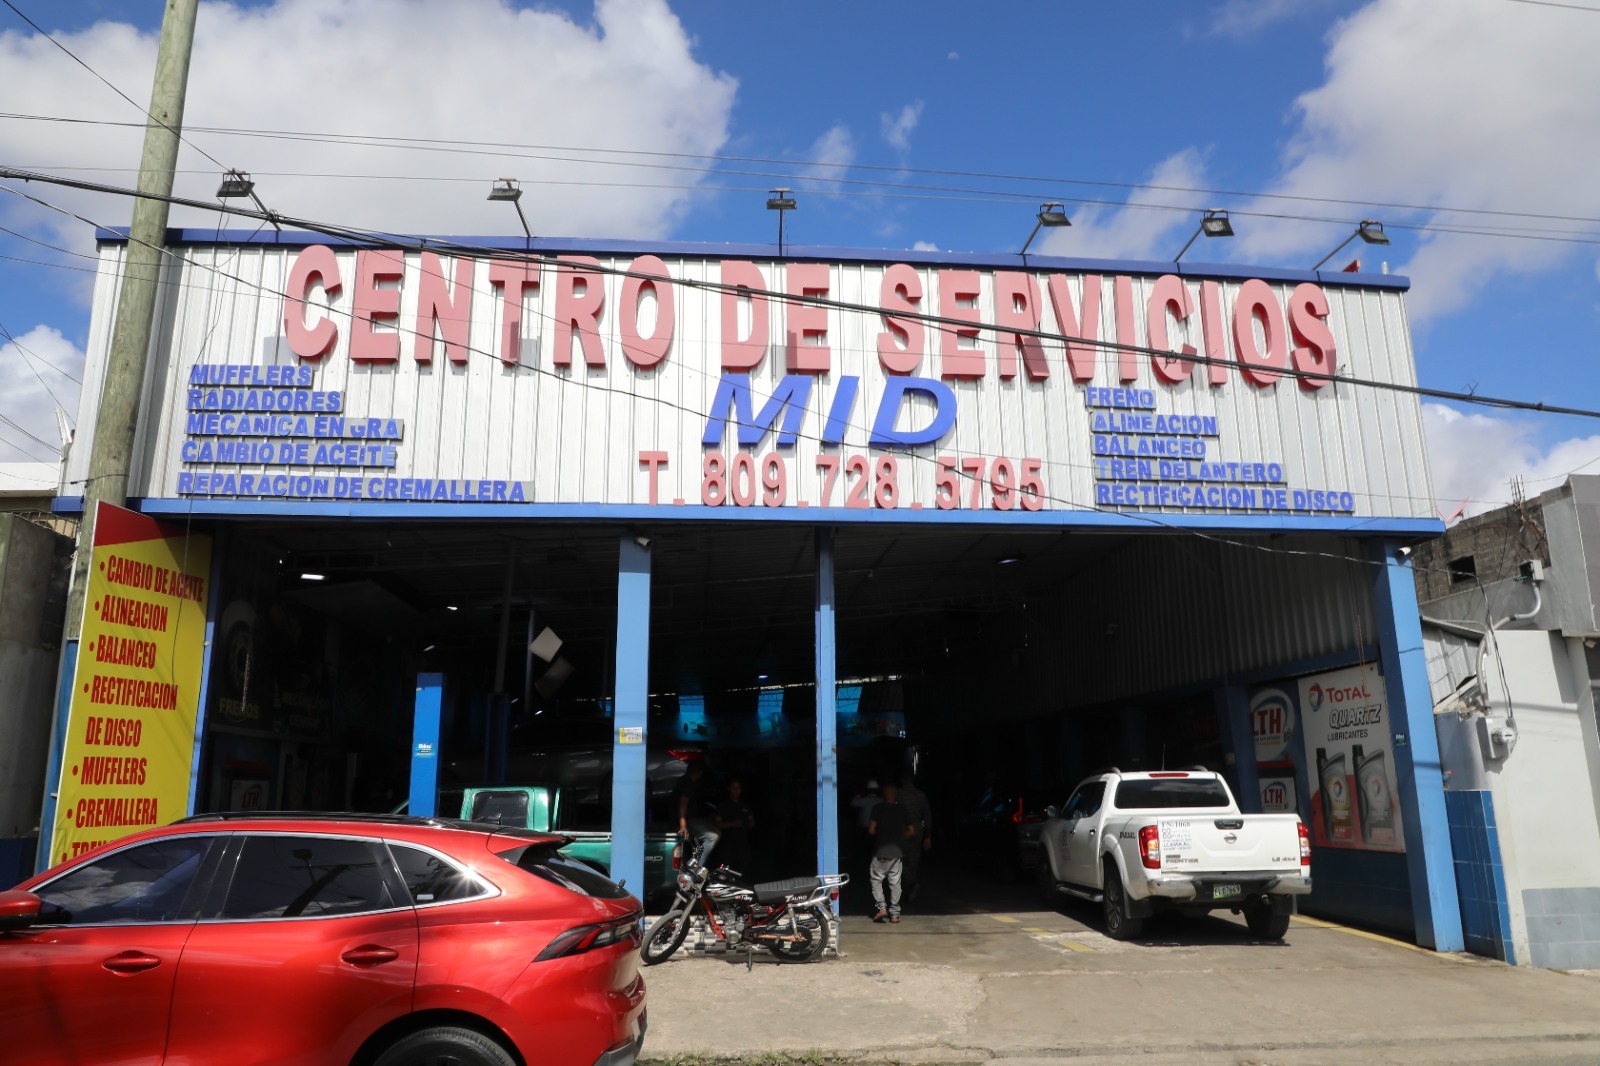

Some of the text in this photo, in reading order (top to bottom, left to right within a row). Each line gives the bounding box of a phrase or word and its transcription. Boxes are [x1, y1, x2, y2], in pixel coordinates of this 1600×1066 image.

[284, 244, 1337, 390] CENTRO DE SERVICIOS
[189, 364, 313, 386] MUFFLERS
[187, 389, 341, 411] RADIADORES
[1086, 387, 1154, 408] FRENO
[701, 374, 957, 448] MID
[1094, 411, 1217, 435] ALINEACION
[186, 413, 309, 436] MECANICA
[314, 416, 345, 437] EN
[181, 441, 397, 466] CAMBIO DE ACEITE
[1094, 435, 1206, 459] BALANCEO
[1095, 458, 1283, 483] TREN DELANTERO
[177, 472, 525, 503] REPARACION DE CREMALLERA
[1097, 484, 1355, 512] RECTIFICACION DE DISCO
[107, 554, 205, 602] CAMBIO DE ACEITE
[101, 594, 168, 633] ALINEACION
[95, 634, 157, 670] BALANCEO
[90, 675, 179, 711] RECTIFICACION
[1325, 685, 1371, 704] TOTAL
[1251, 707, 1282, 736] LTH
[1329, 704, 1382, 729] QUARTZ
[85, 716, 142, 748] DE DISCO
[1327, 729, 1369, 742] LUBRICANTES
[81, 757, 147, 786] MUFFLERS
[1264, 787, 1283, 804] LTH
[75, 797, 158, 829] CREMALLERA
